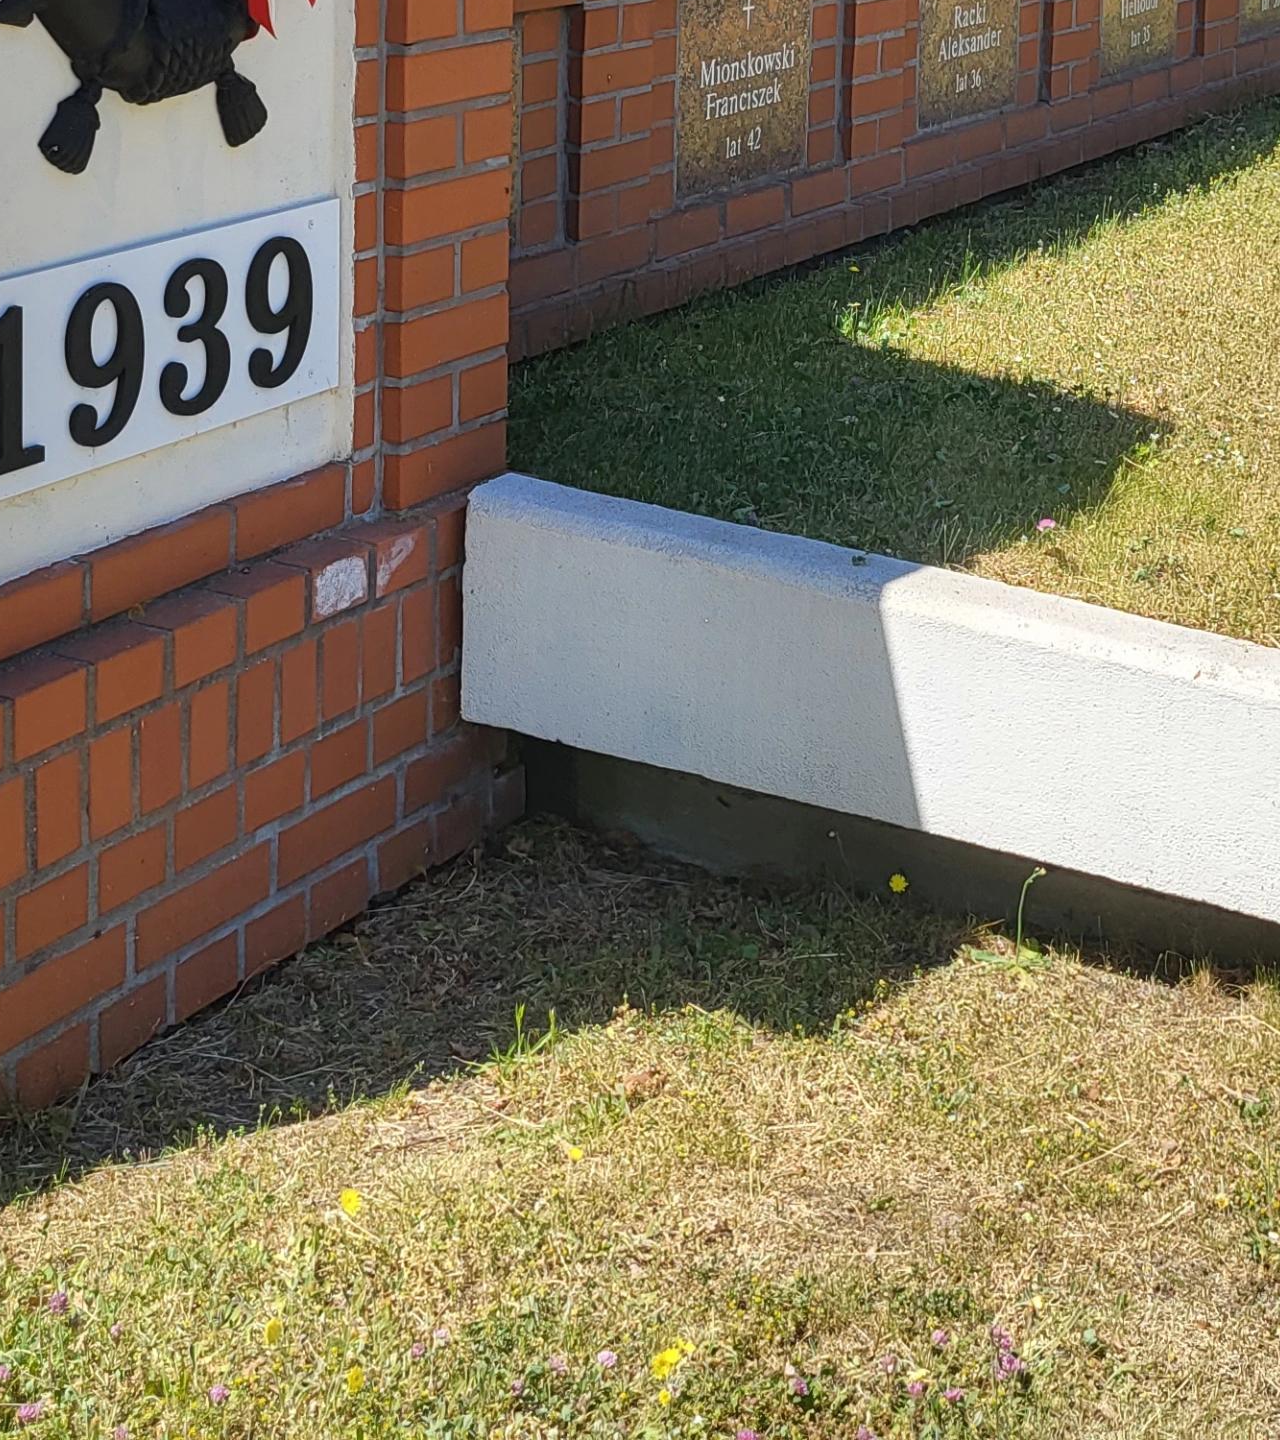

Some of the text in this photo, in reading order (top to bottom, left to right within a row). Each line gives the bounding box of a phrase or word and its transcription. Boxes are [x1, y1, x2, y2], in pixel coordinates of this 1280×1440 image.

[954, 0, 986, 29] Racki
[938, 26, 1002, 63] Aleksander
[700, 42, 795, 89] Mionskowski
[956, 67, 981, 93] lat 36
[706, 78, 782, 120] Franciszek
[726, 126, 761, 159] lat 42
